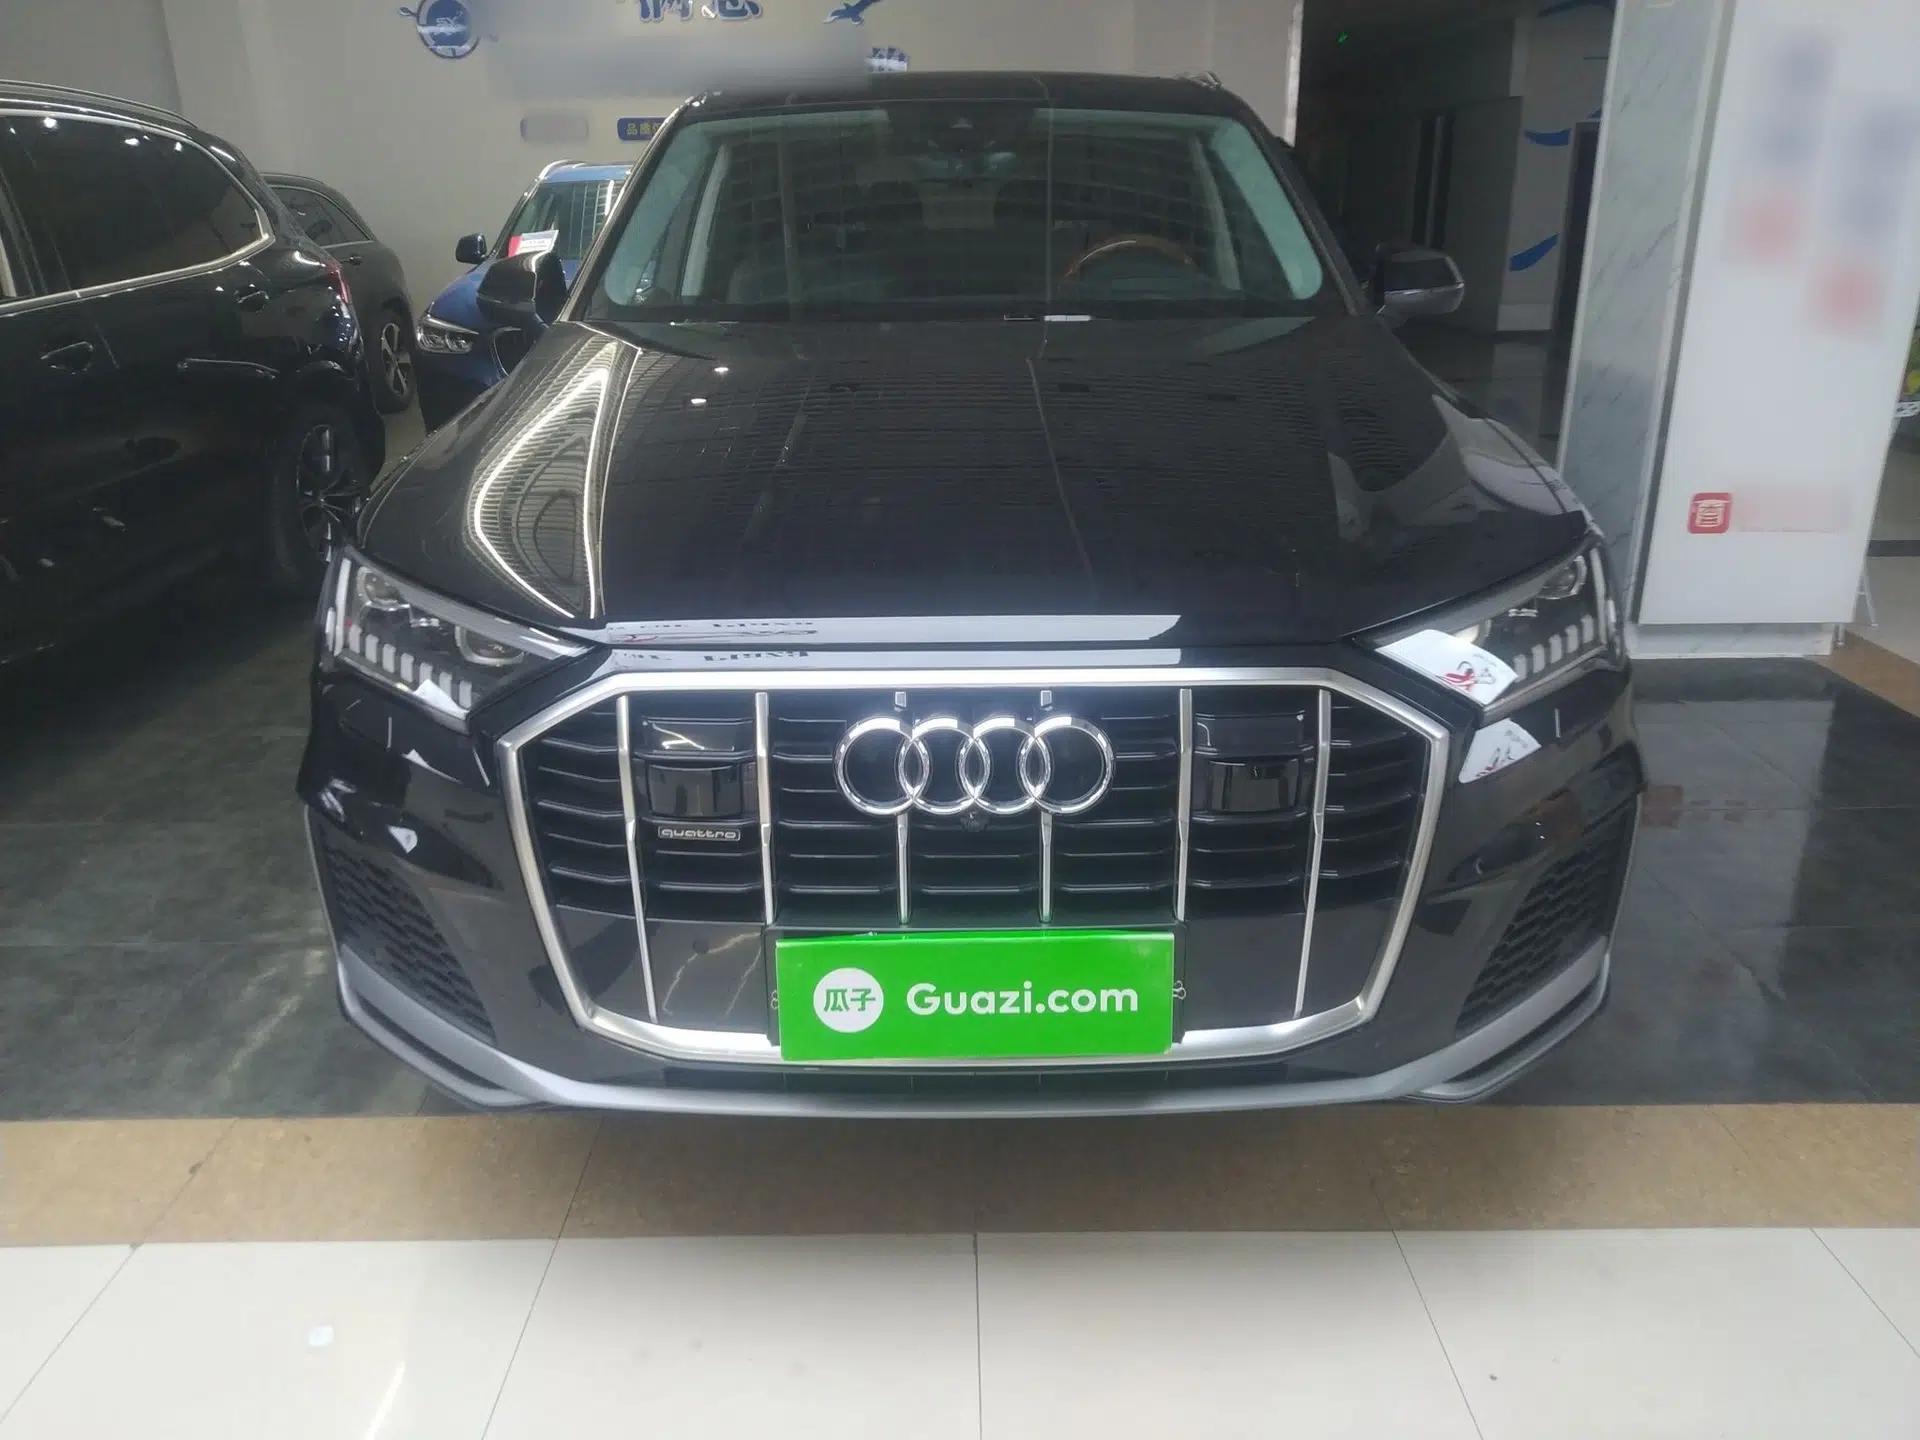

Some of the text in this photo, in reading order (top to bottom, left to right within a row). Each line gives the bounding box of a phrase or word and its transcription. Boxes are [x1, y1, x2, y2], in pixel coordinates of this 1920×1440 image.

[660, 828, 737, 839] quattro
[823, 988, 876, 1012] 瓜子
[906, 980, 1138, 1016] Guazi.com
